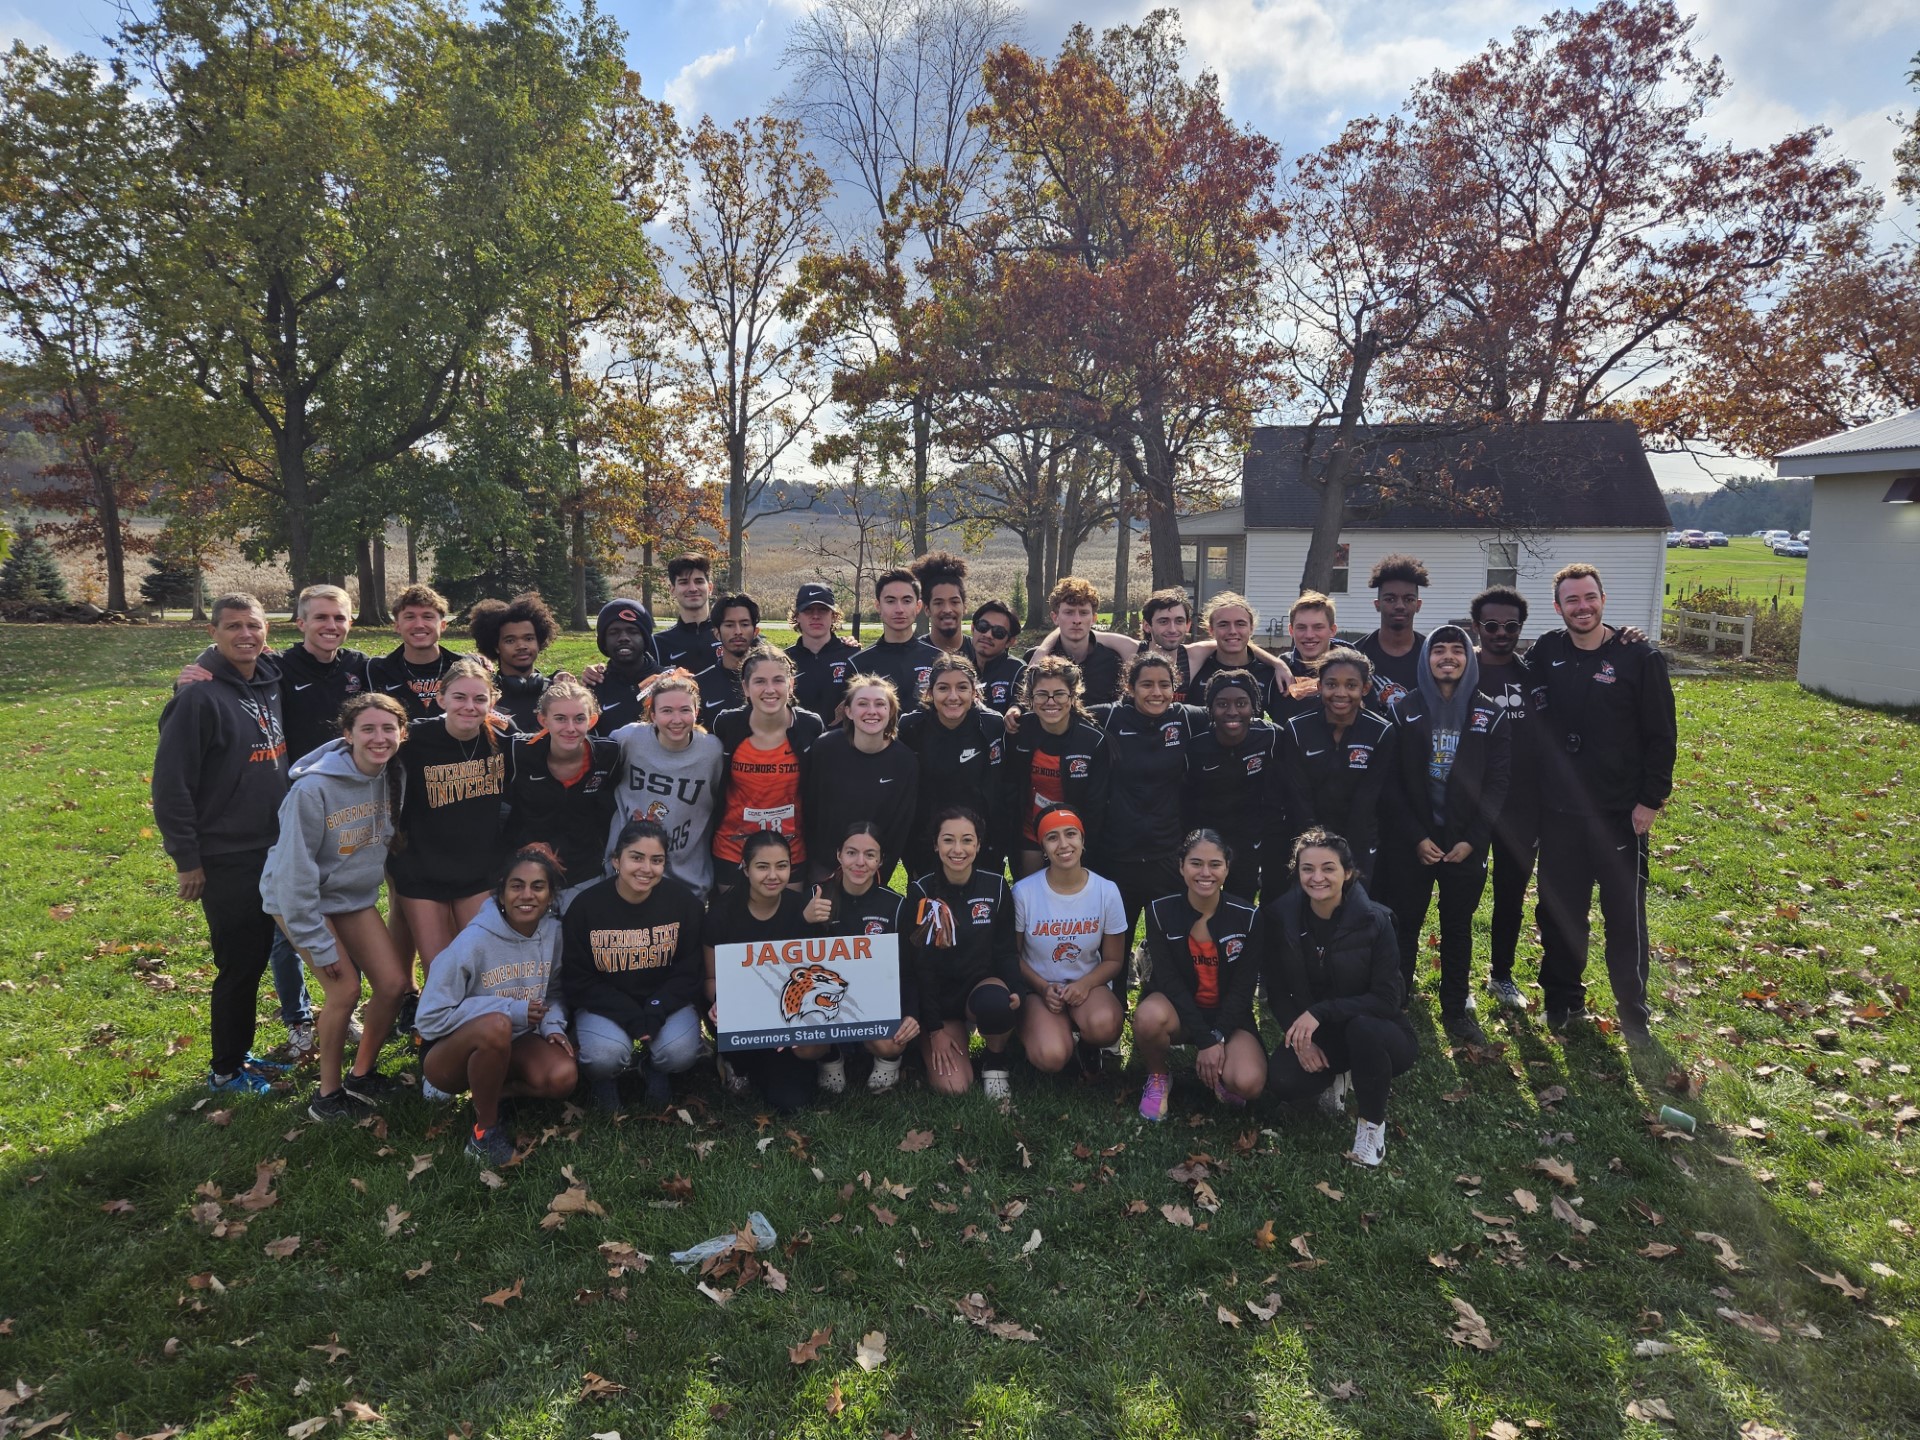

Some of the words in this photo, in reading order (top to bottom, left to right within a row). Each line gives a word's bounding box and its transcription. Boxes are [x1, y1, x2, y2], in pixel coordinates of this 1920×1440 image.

[424, 758, 485, 782] GOVERNORS
[630, 764, 706, 806] GSU
[758, 816, 782, 834] 18
[590, 928, 650, 948] GOVERNORS
[652, 922, 680, 944] STATE
[1032, 919, 1100, 936] JAGUARS
[592, 940, 678, 973] UNIVERSITY
[741, 937, 873, 968] JAGUAR
[731, 1033, 791, 1046] Governors
[795, 1030, 826, 1041] State
[830, 1025, 889, 1039] University
